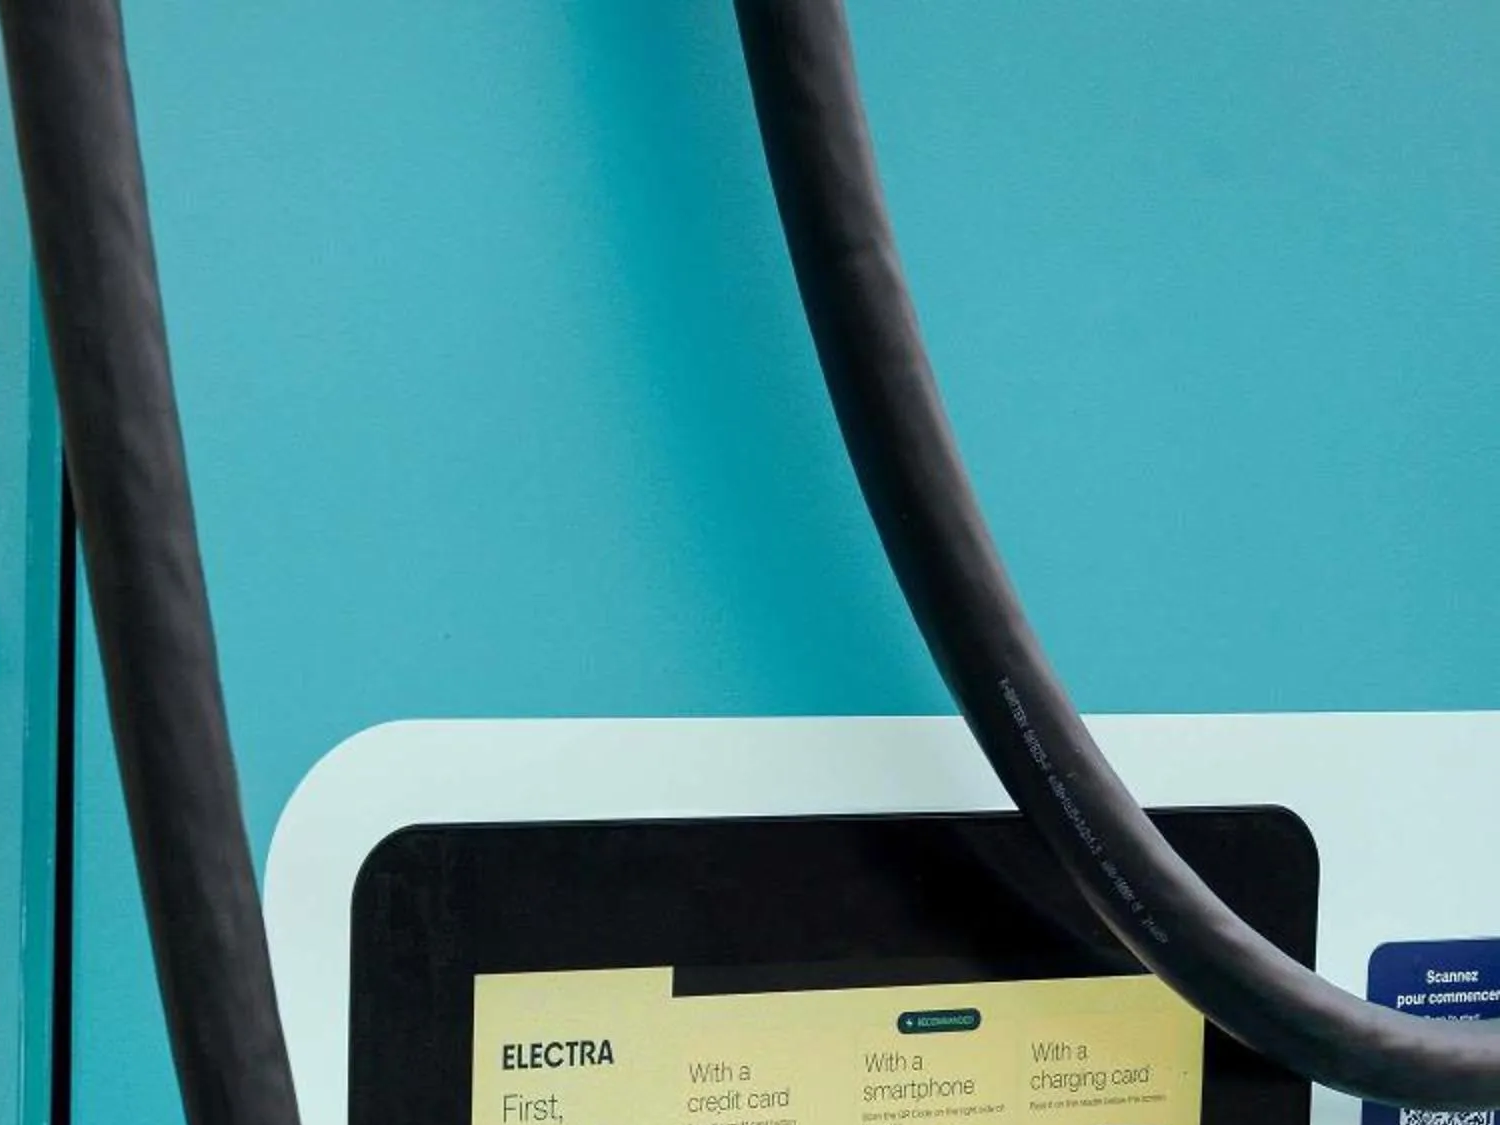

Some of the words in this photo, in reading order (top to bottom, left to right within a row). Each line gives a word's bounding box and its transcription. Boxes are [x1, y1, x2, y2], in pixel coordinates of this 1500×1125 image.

[1426, 969, 1479, 984] Scannez
[1396, 993, 1427, 1009] pour
[503, 1039, 614, 1070] ELECTRA
[865, 1052, 906, 1073] With
[912, 1056, 923, 1071] a
[1032, 1042, 1071, 1062] With
[1077, 1045, 1087, 1061] a
[689, 1062, 733, 1083] With
[739, 1065, 751, 1081] a
[1030, 1070, 1106, 1092] charging
[1112, 1064, 1151, 1085] card
[687, 1090, 741, 1113] credit
[747, 1086, 790, 1109] card
[863, 1078, 975, 1103] smartphone
[503, 1093, 563, 1124] First,
